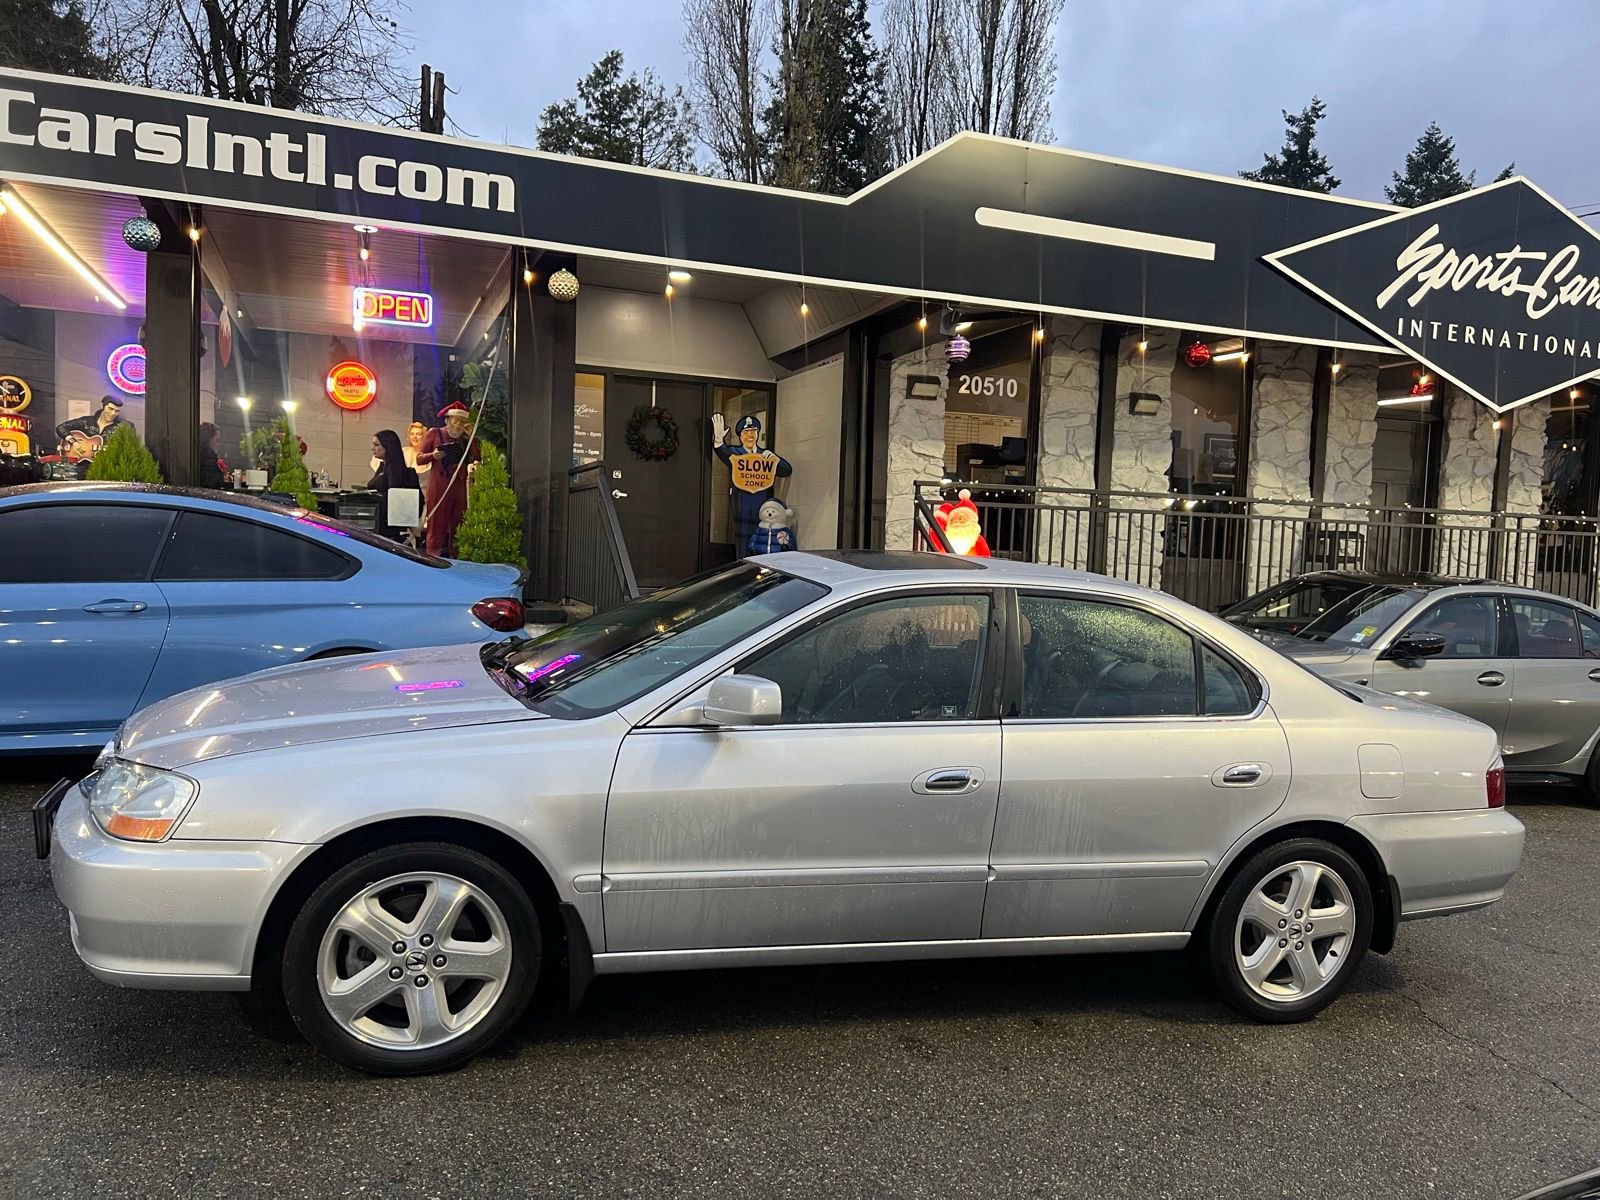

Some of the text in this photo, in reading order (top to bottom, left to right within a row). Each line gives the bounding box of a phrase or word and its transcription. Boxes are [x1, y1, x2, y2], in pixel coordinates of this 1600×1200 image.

[0, 88, 517, 212] CarsIntl.com
[1376, 223, 1548, 308] Sports
[361, 292, 428, 322] OPEN
[958, 374, 1018, 398] 20510
[737, 459, 774, 472] SLOW
[740, 472, 769, 480] SCHOOL
